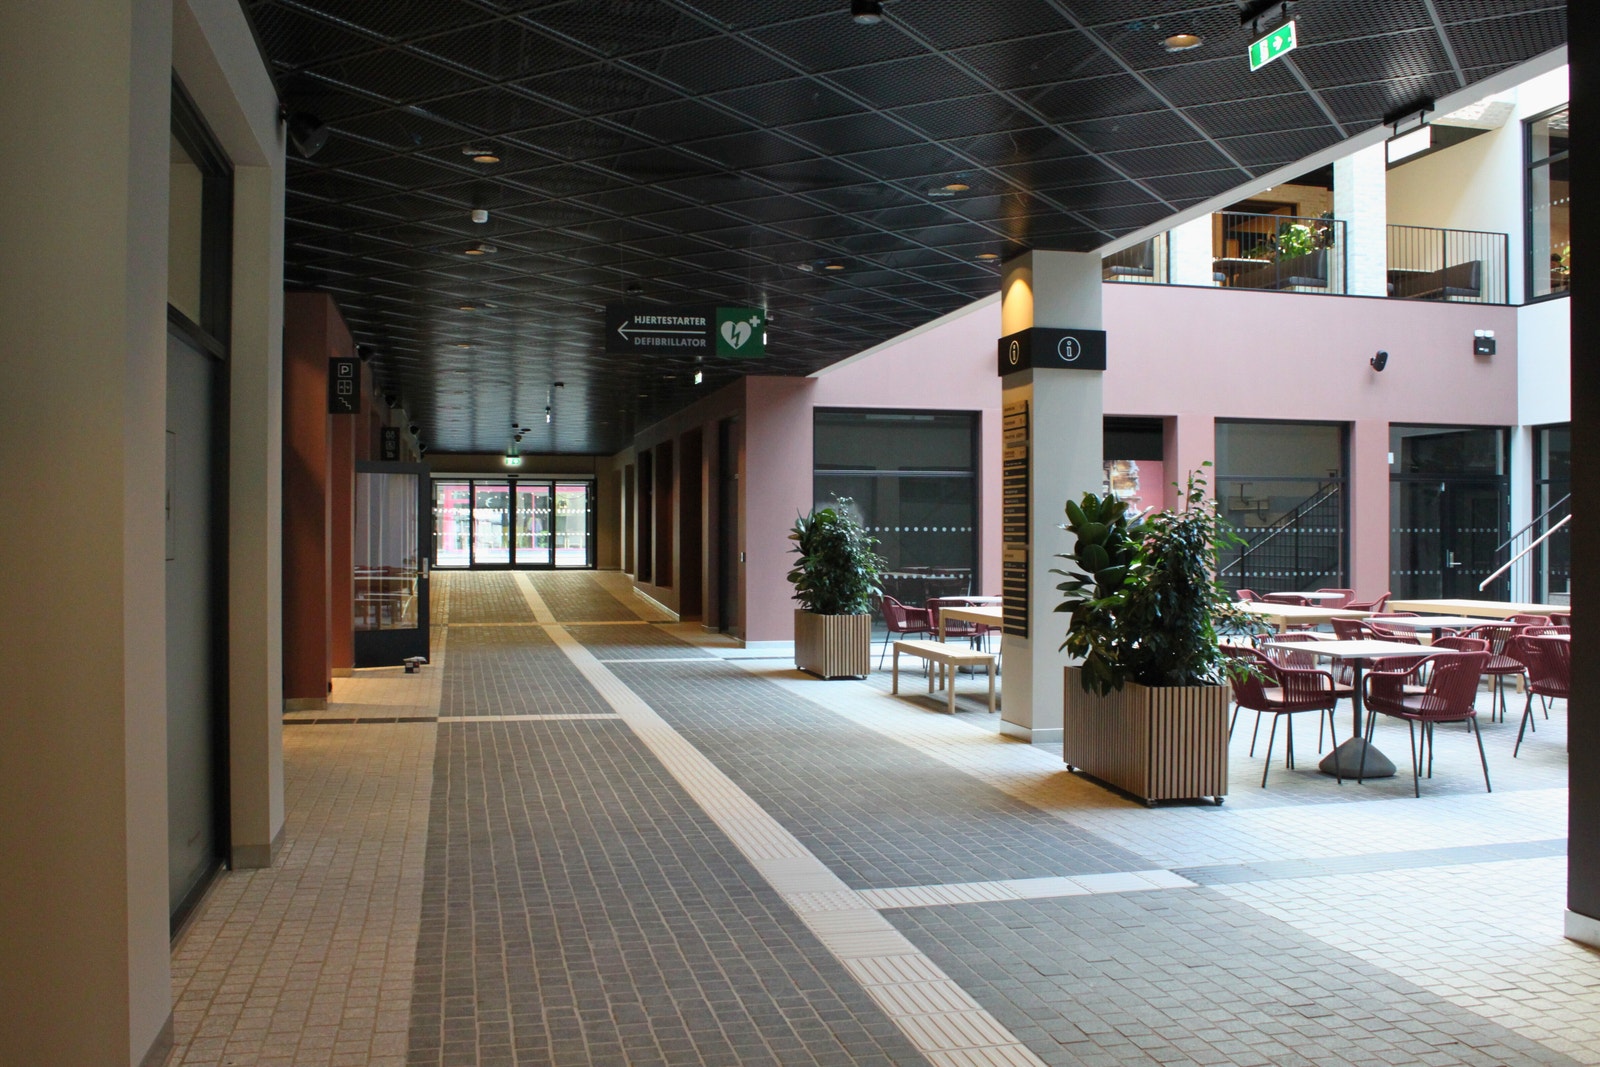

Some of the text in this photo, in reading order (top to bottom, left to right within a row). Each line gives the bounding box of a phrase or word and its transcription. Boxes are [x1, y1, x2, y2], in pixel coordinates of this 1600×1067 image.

[634, 315, 706, 326] HJERTESTARTER
[634, 337, 706, 347] DEFIBRILLATOR
[341, 365, 349, 374] P
